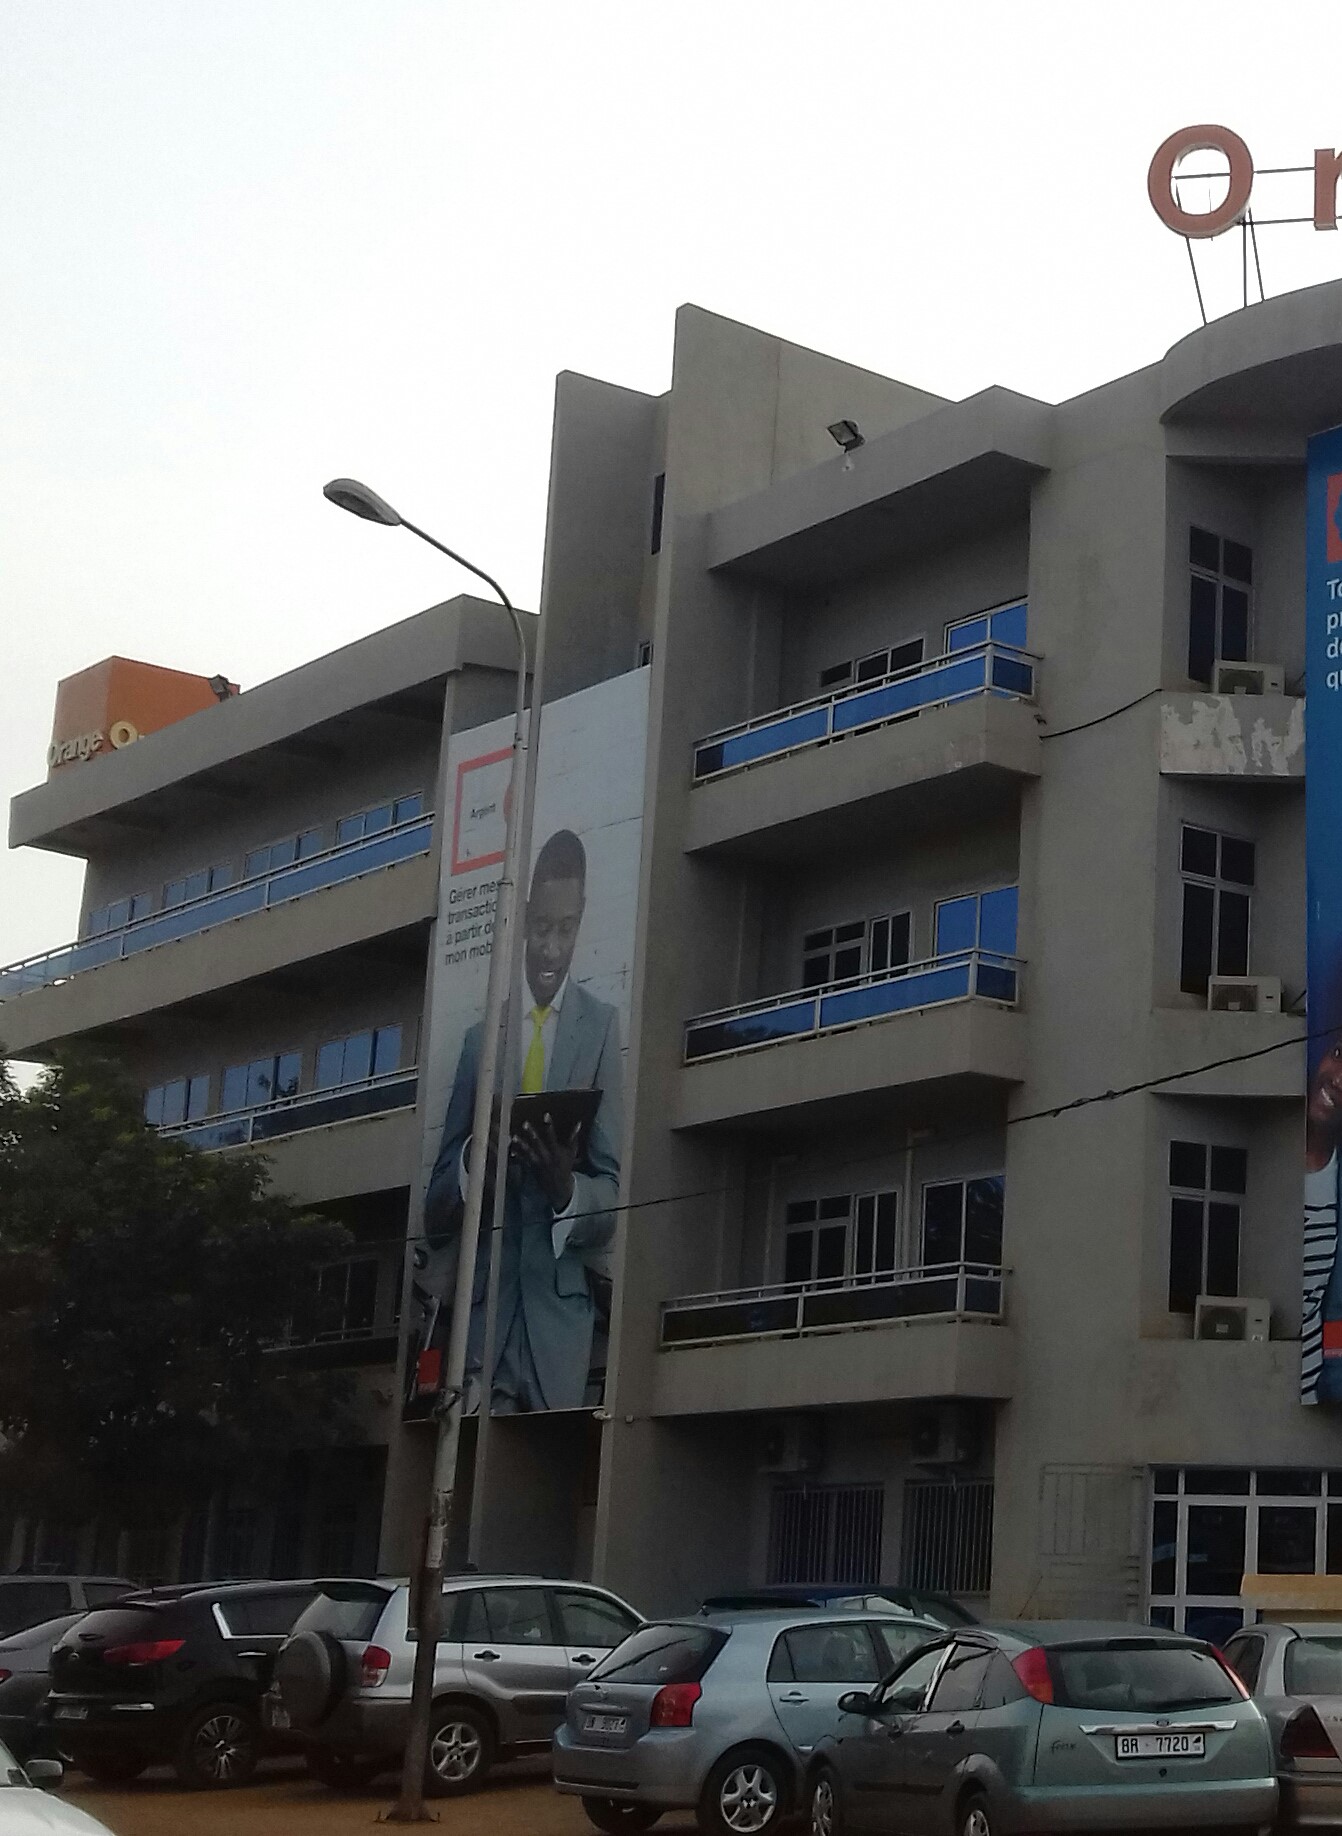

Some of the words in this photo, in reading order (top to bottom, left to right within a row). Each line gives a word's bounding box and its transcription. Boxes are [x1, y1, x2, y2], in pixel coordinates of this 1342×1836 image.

[454, 923, 483, 946] partir
[444, 948, 468, 966] mon
[1155, 1735, 1189, 1753] 7720
